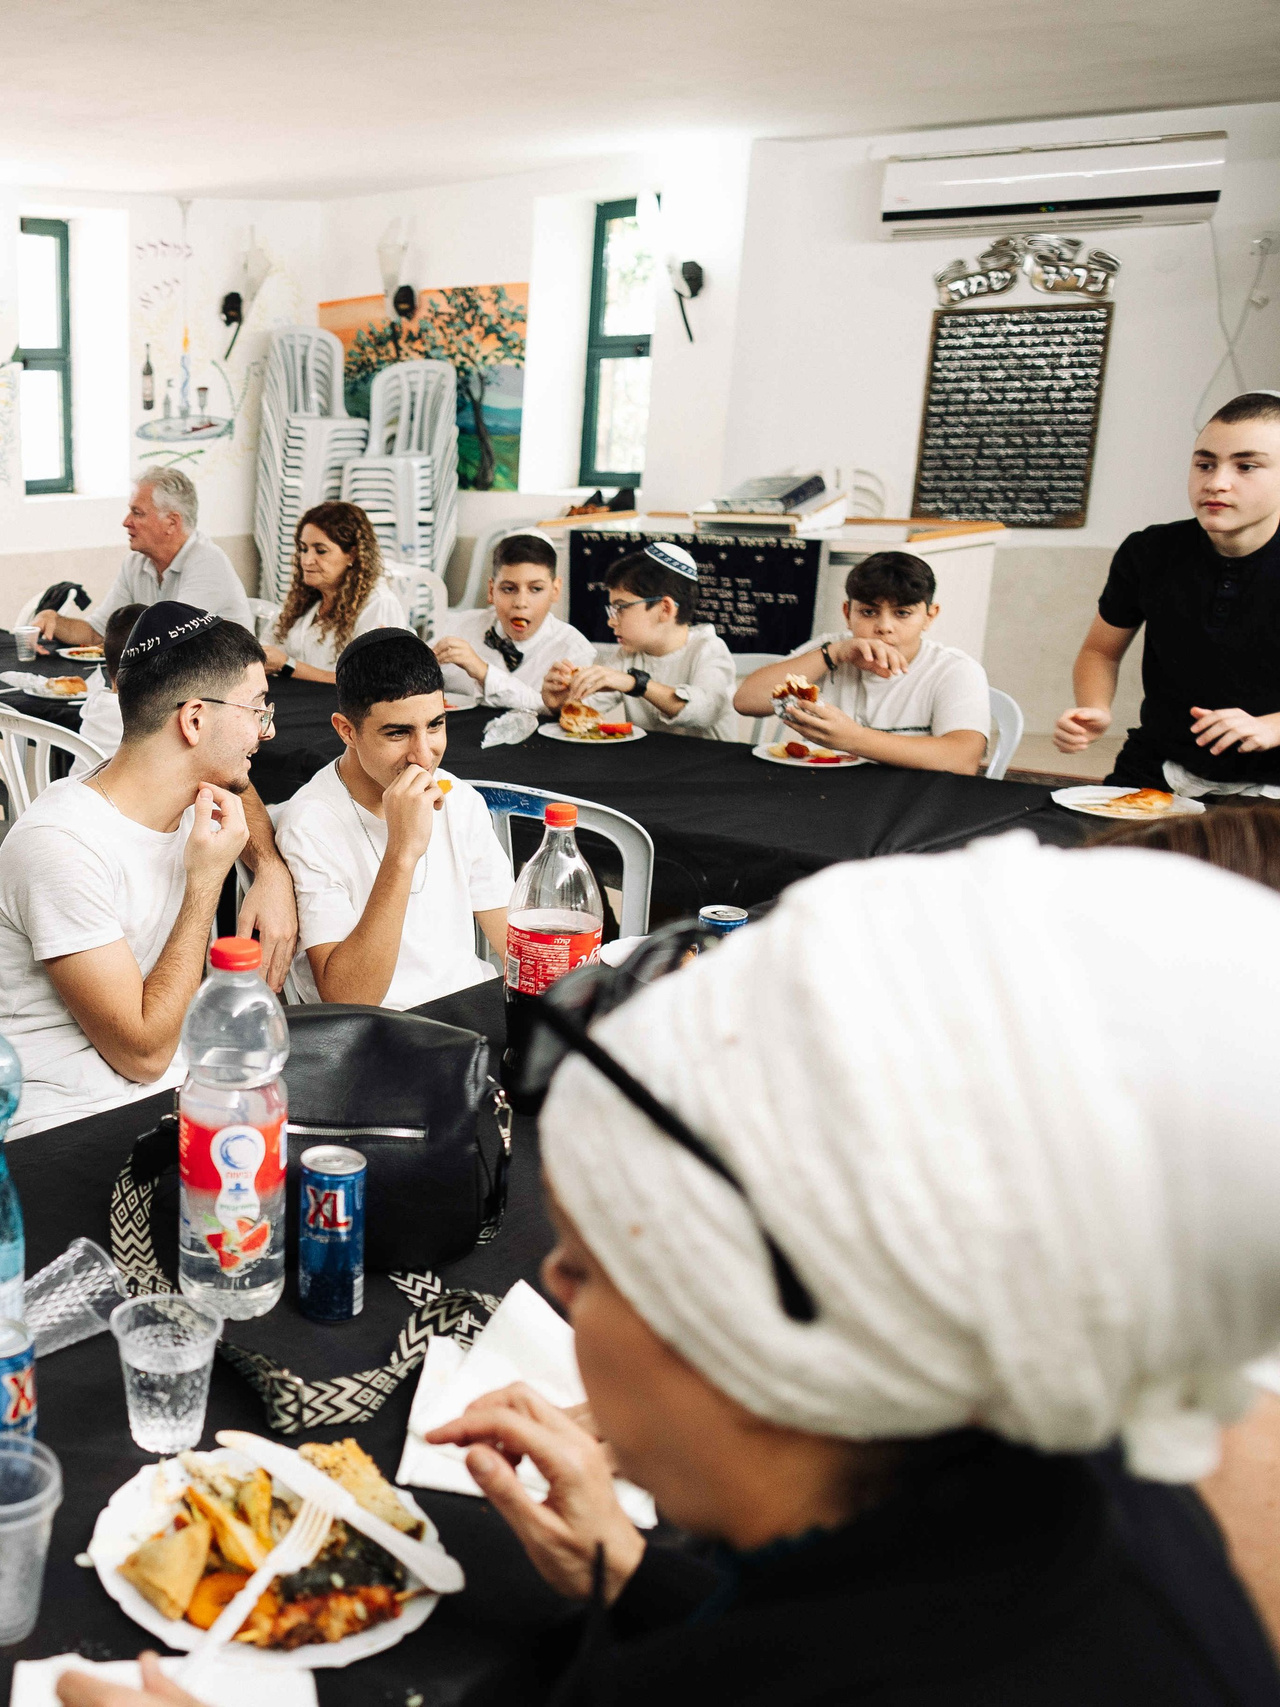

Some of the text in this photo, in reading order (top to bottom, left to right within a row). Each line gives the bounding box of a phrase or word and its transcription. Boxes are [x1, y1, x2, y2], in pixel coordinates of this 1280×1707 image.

[168, 616, 208, 639] לעולם
[139, 636, 161, 652] ועד
[553, 937, 571, 946] קולה
[306, 1185, 353, 1231] XL
